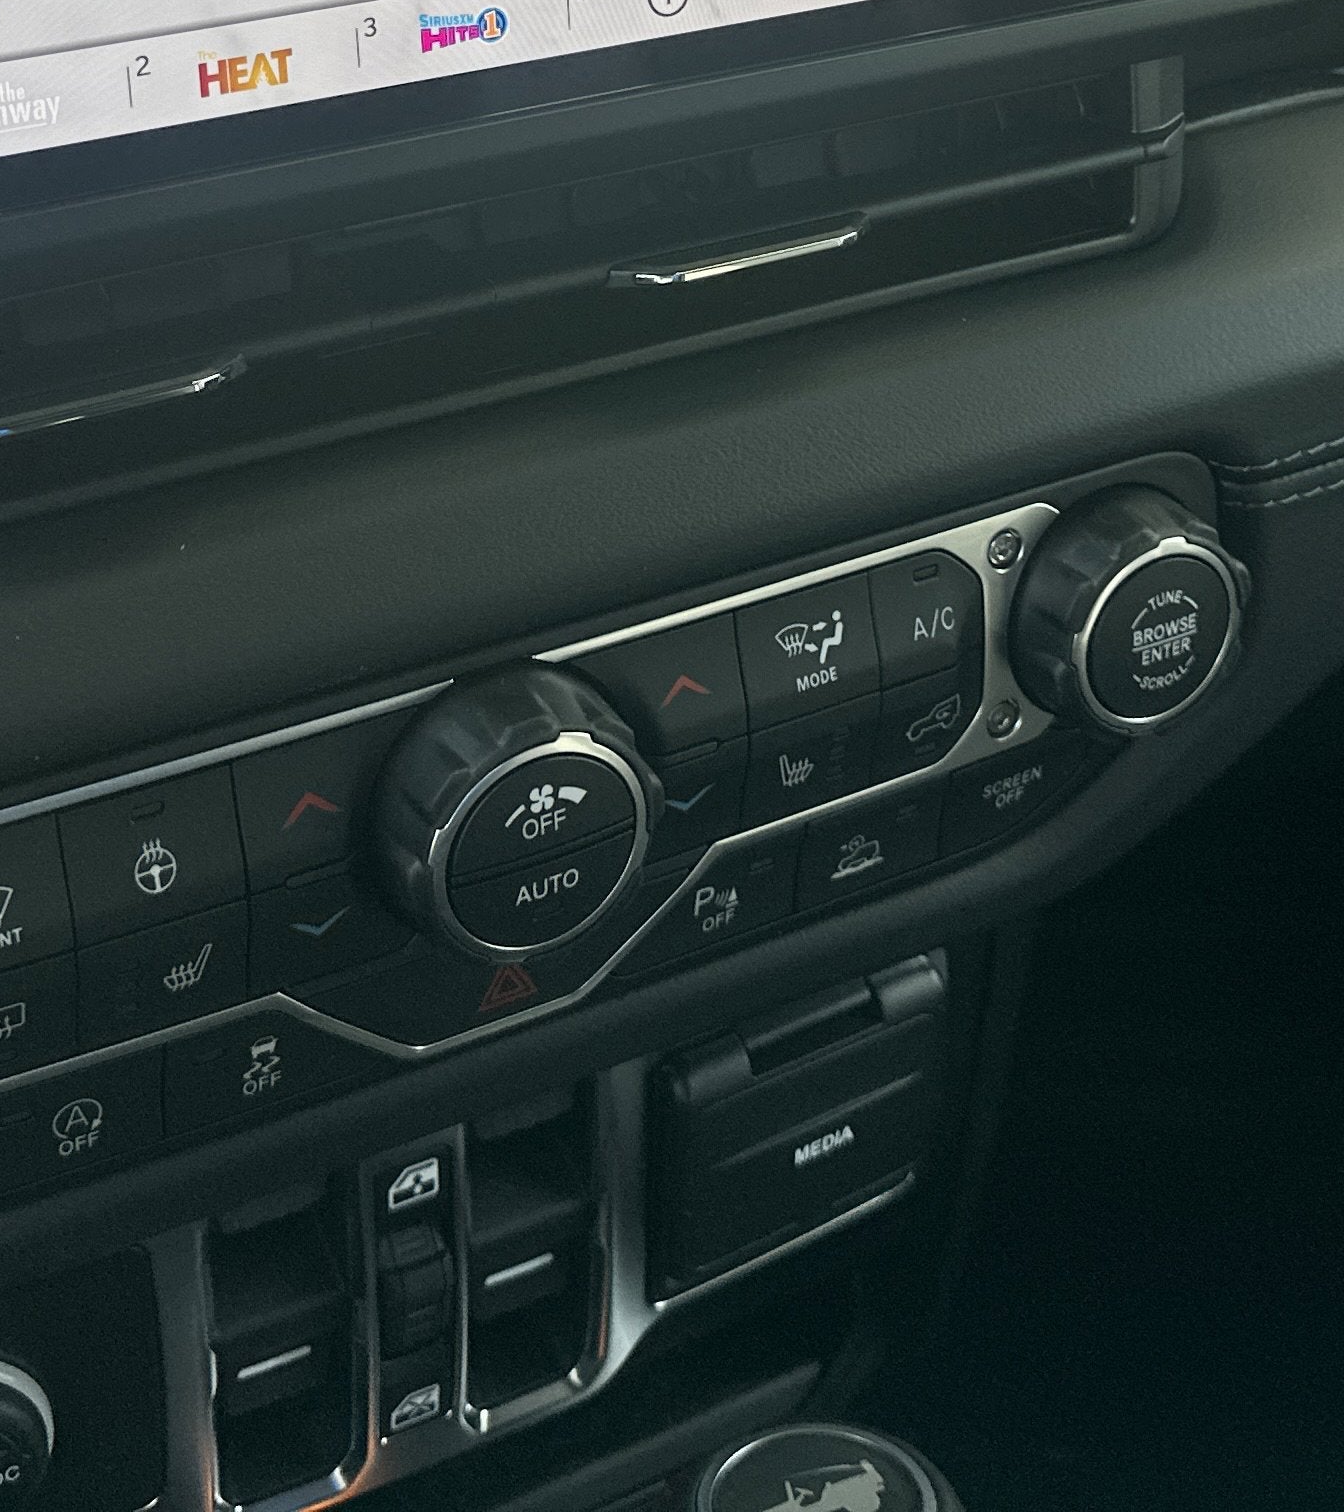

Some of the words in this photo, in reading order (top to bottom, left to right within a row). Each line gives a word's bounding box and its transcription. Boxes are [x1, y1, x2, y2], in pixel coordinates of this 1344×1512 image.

[363, 17, 378, 38] 3
[135, 55, 151, 78] 2
[198, 48, 293, 98] HEAT
[1148, 590, 1183, 610] TUNE
[912, 605, 956, 642] A/C
[1133, 612, 1197, 646] BROWSE
[1141, 638, 1191, 666] ENTER
[795, 666, 840, 692] MODE
[1139, 665, 1187, 689] SCROLL
[982, 765, 1043, 801] SCREEN
[994, 784, 1026, 808] OFF
[522, 808, 566, 839] OFF
[515, 867, 580, 906] AUTO
[701, 904, 737, 932] OFF
[242, 1069, 284, 1096] OFF
[58, 1129, 101, 1157] OFF
[793, 1125, 855, 1167] MEDIA
